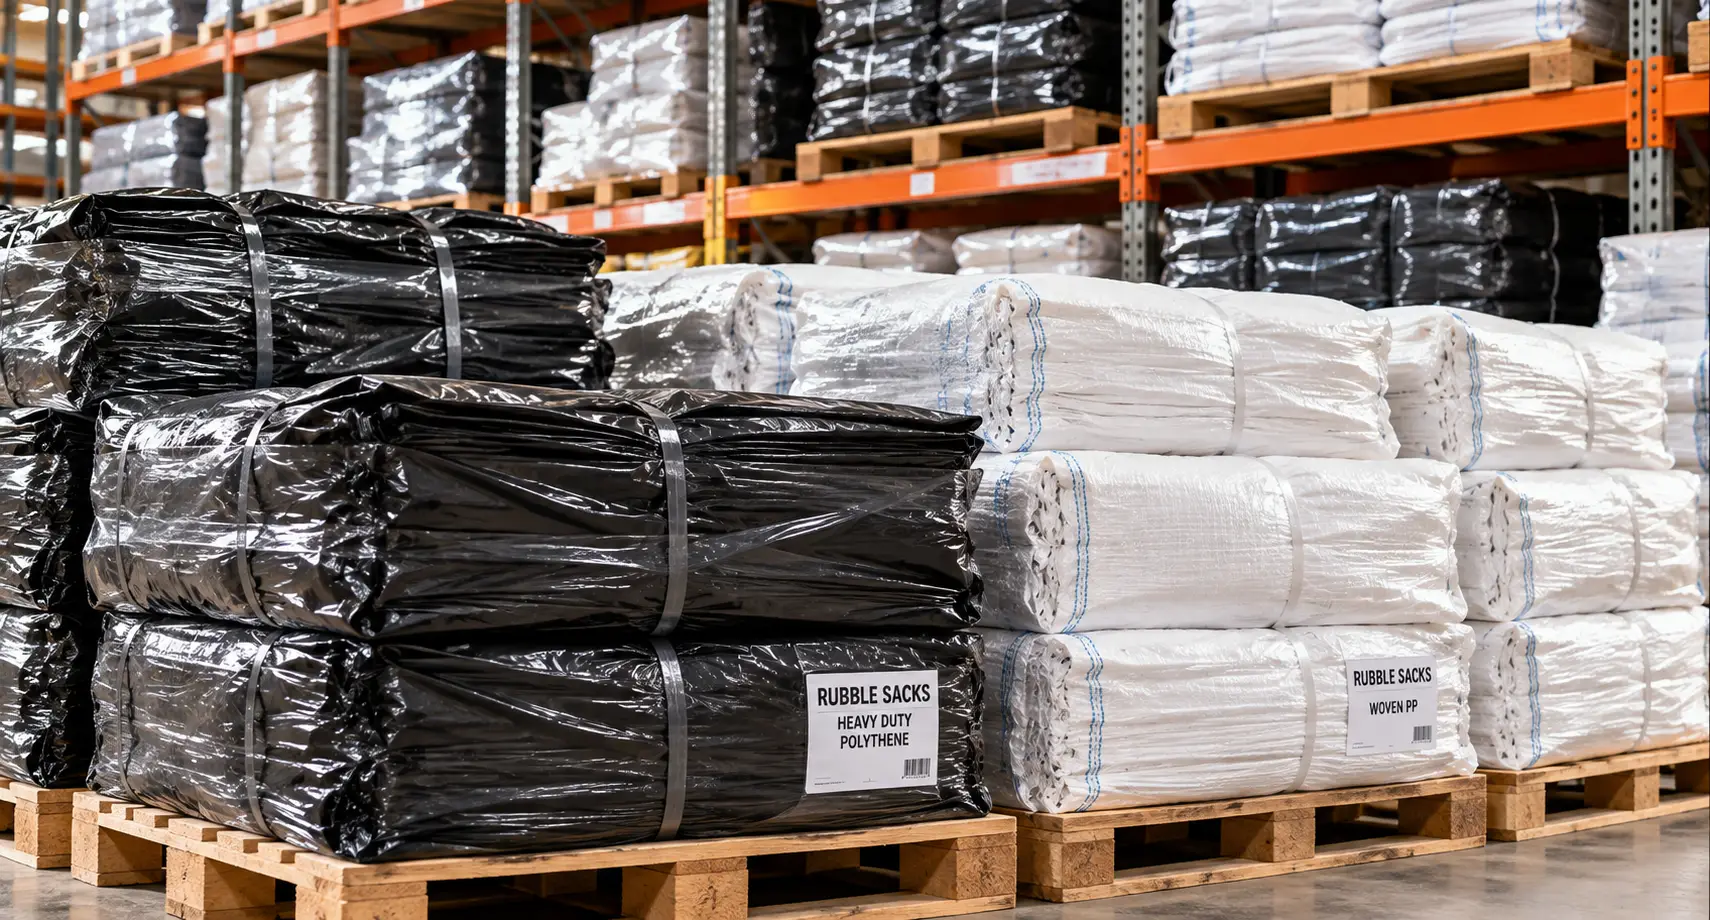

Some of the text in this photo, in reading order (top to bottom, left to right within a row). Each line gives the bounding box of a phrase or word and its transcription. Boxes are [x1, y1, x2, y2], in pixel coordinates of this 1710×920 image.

[1353, 667, 1432, 686] RUBBLE SACKS
[818, 684, 931, 706] RUBBLE SACKS
[1369, 699, 1418, 715] WOVEN PP
[838, 713, 912, 730] HEAVY DUTY
[840, 732, 909, 749] POLYTHENE
